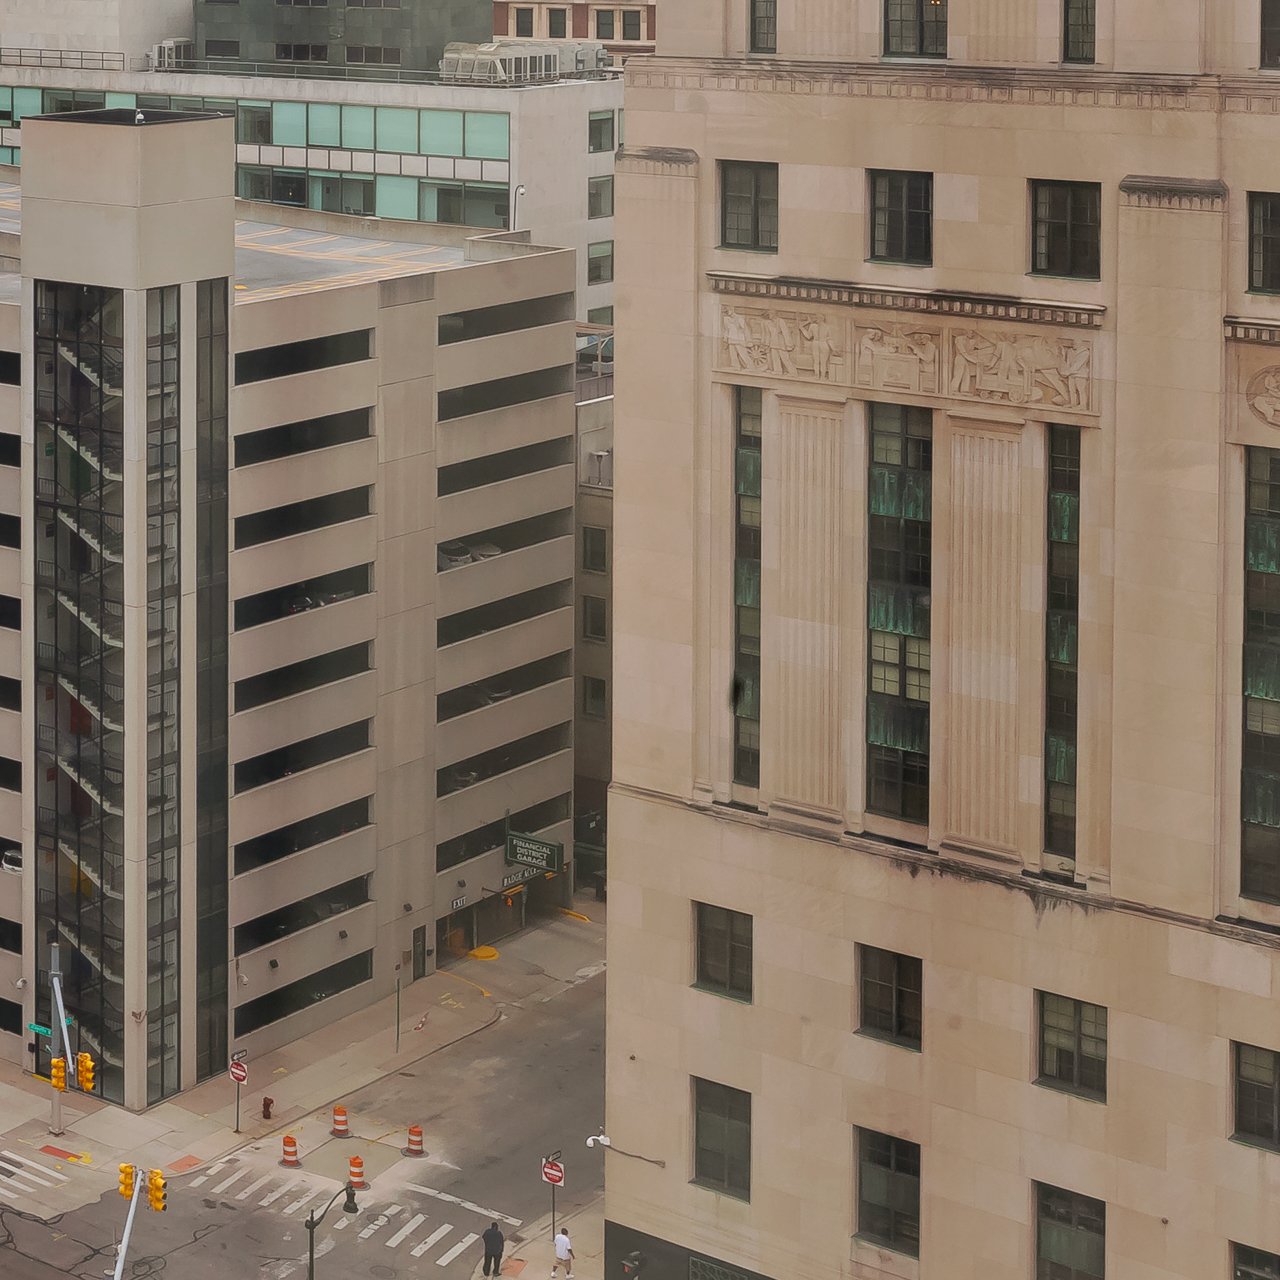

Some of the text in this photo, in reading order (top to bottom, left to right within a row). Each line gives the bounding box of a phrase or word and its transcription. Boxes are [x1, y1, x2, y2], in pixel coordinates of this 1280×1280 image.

[513, 839, 551, 855] FINANCIAL
[516, 847, 547, 860] DISTRICT
[517, 854, 547, 867] GARAGE
[453, 896, 466, 909] EXIT
